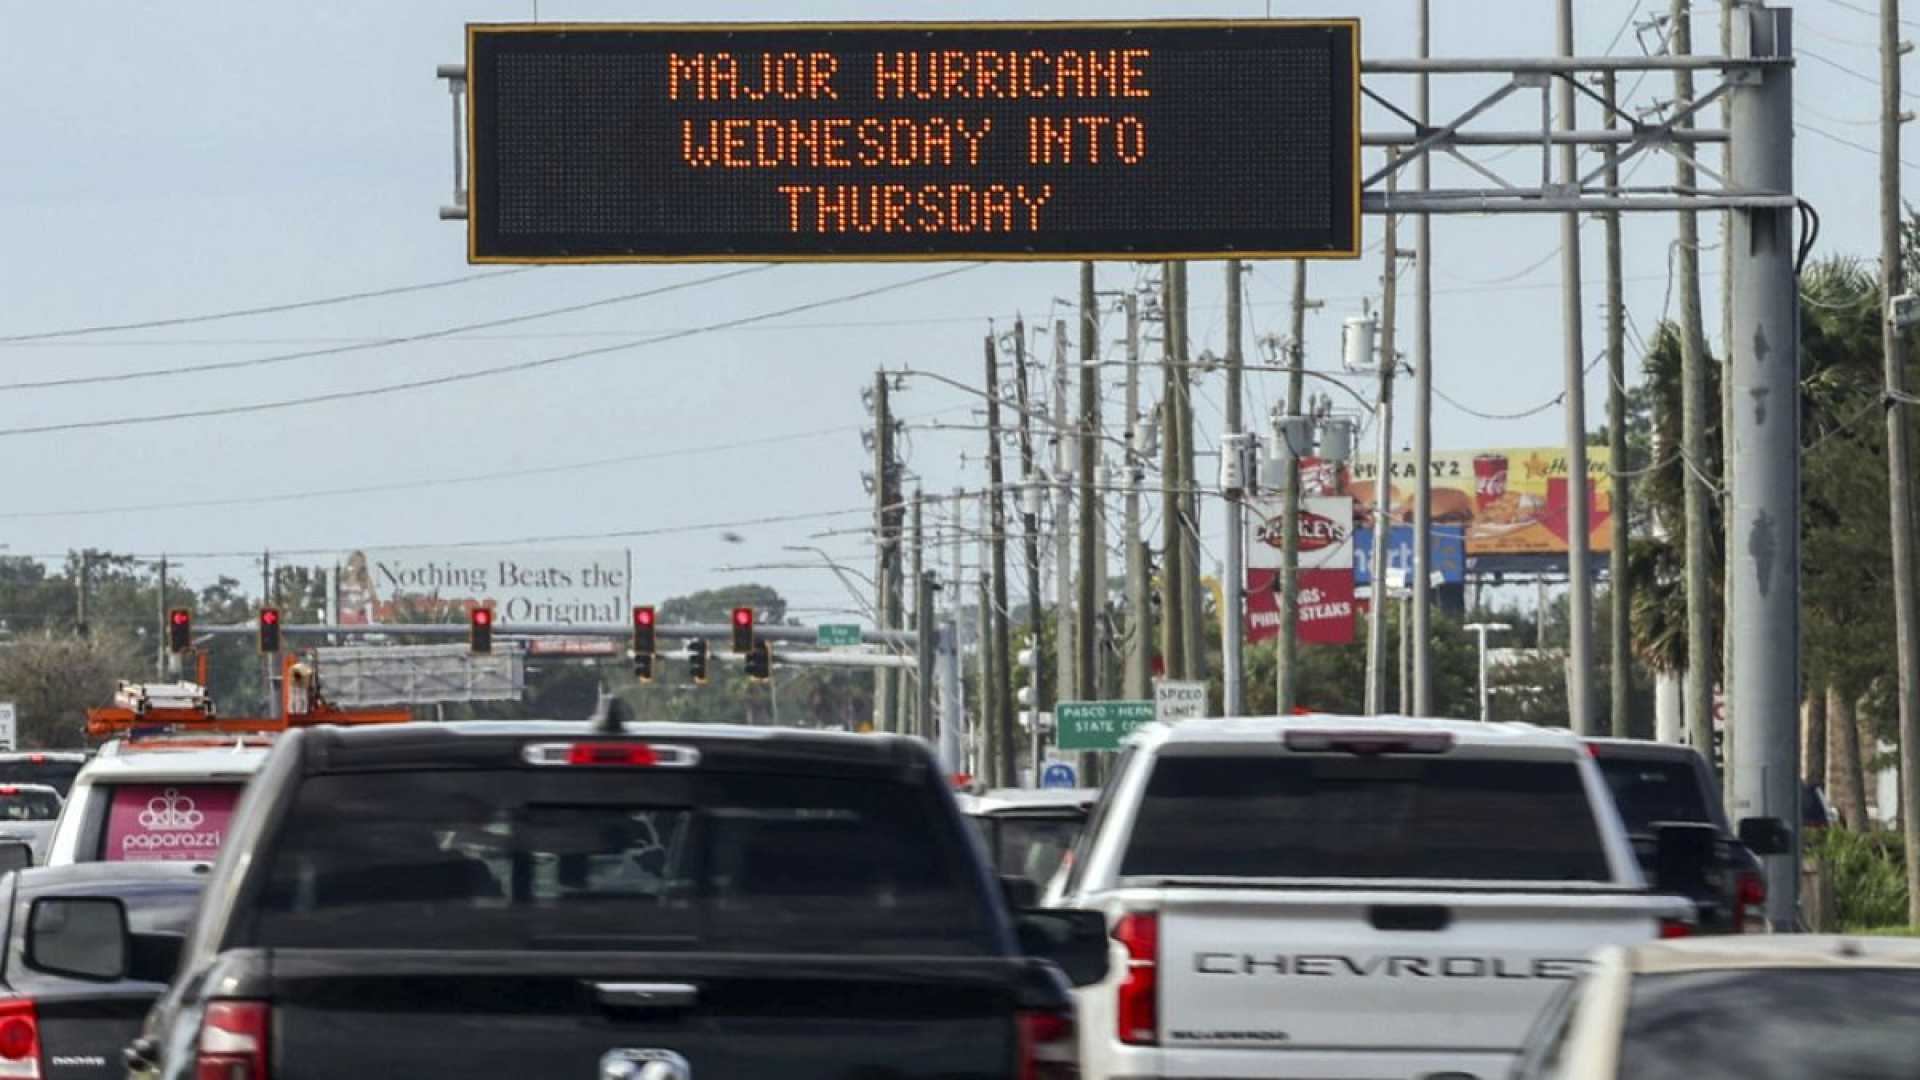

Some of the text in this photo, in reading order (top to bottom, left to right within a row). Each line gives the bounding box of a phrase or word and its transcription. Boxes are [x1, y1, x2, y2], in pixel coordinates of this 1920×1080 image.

[667, 48, 1151, 101] MAJOR HURRICANE
[682, 116, 1146, 167] WEDNESDAY INTO
[778, 184, 1053, 232] THURSDAY
[375, 559, 624, 592] Nothing Beats the
[506, 597, 621, 624] Original
[1299, 602, 1351, 621] STEAKS
[1074, 720, 1115, 733] STATE
[123, 832, 219, 852] paparazzi
[1195, 952, 1600, 980] CHEVROLE
